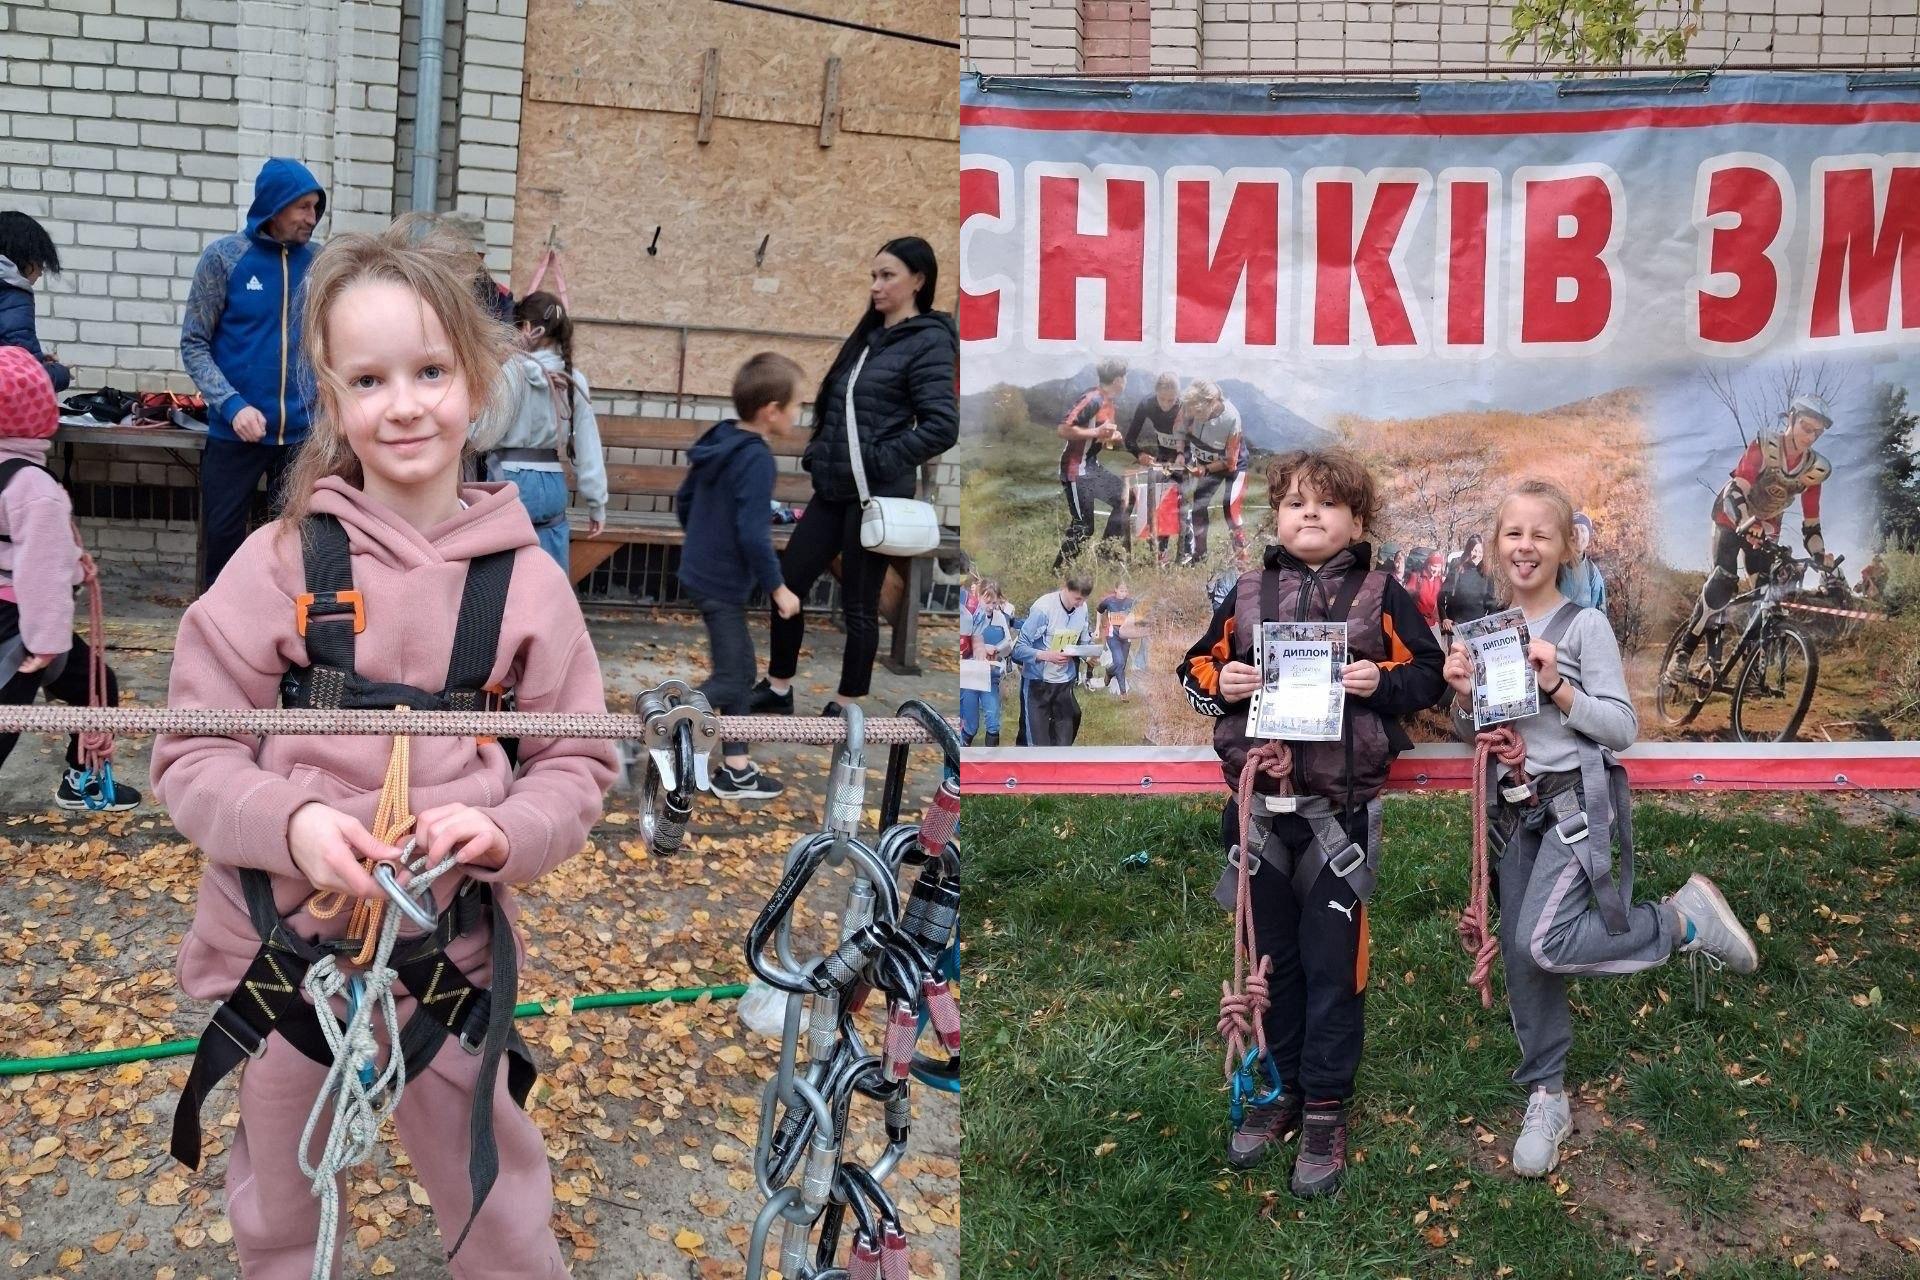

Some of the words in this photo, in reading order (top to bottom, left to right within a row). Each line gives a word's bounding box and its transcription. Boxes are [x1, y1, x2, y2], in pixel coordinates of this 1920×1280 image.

[1699, 167, 1920, 343] ЗМ
[1482, 635, 1517, 651] ДИПЛОМ
[1283, 649, 1328, 658] ДИПЛОМ
